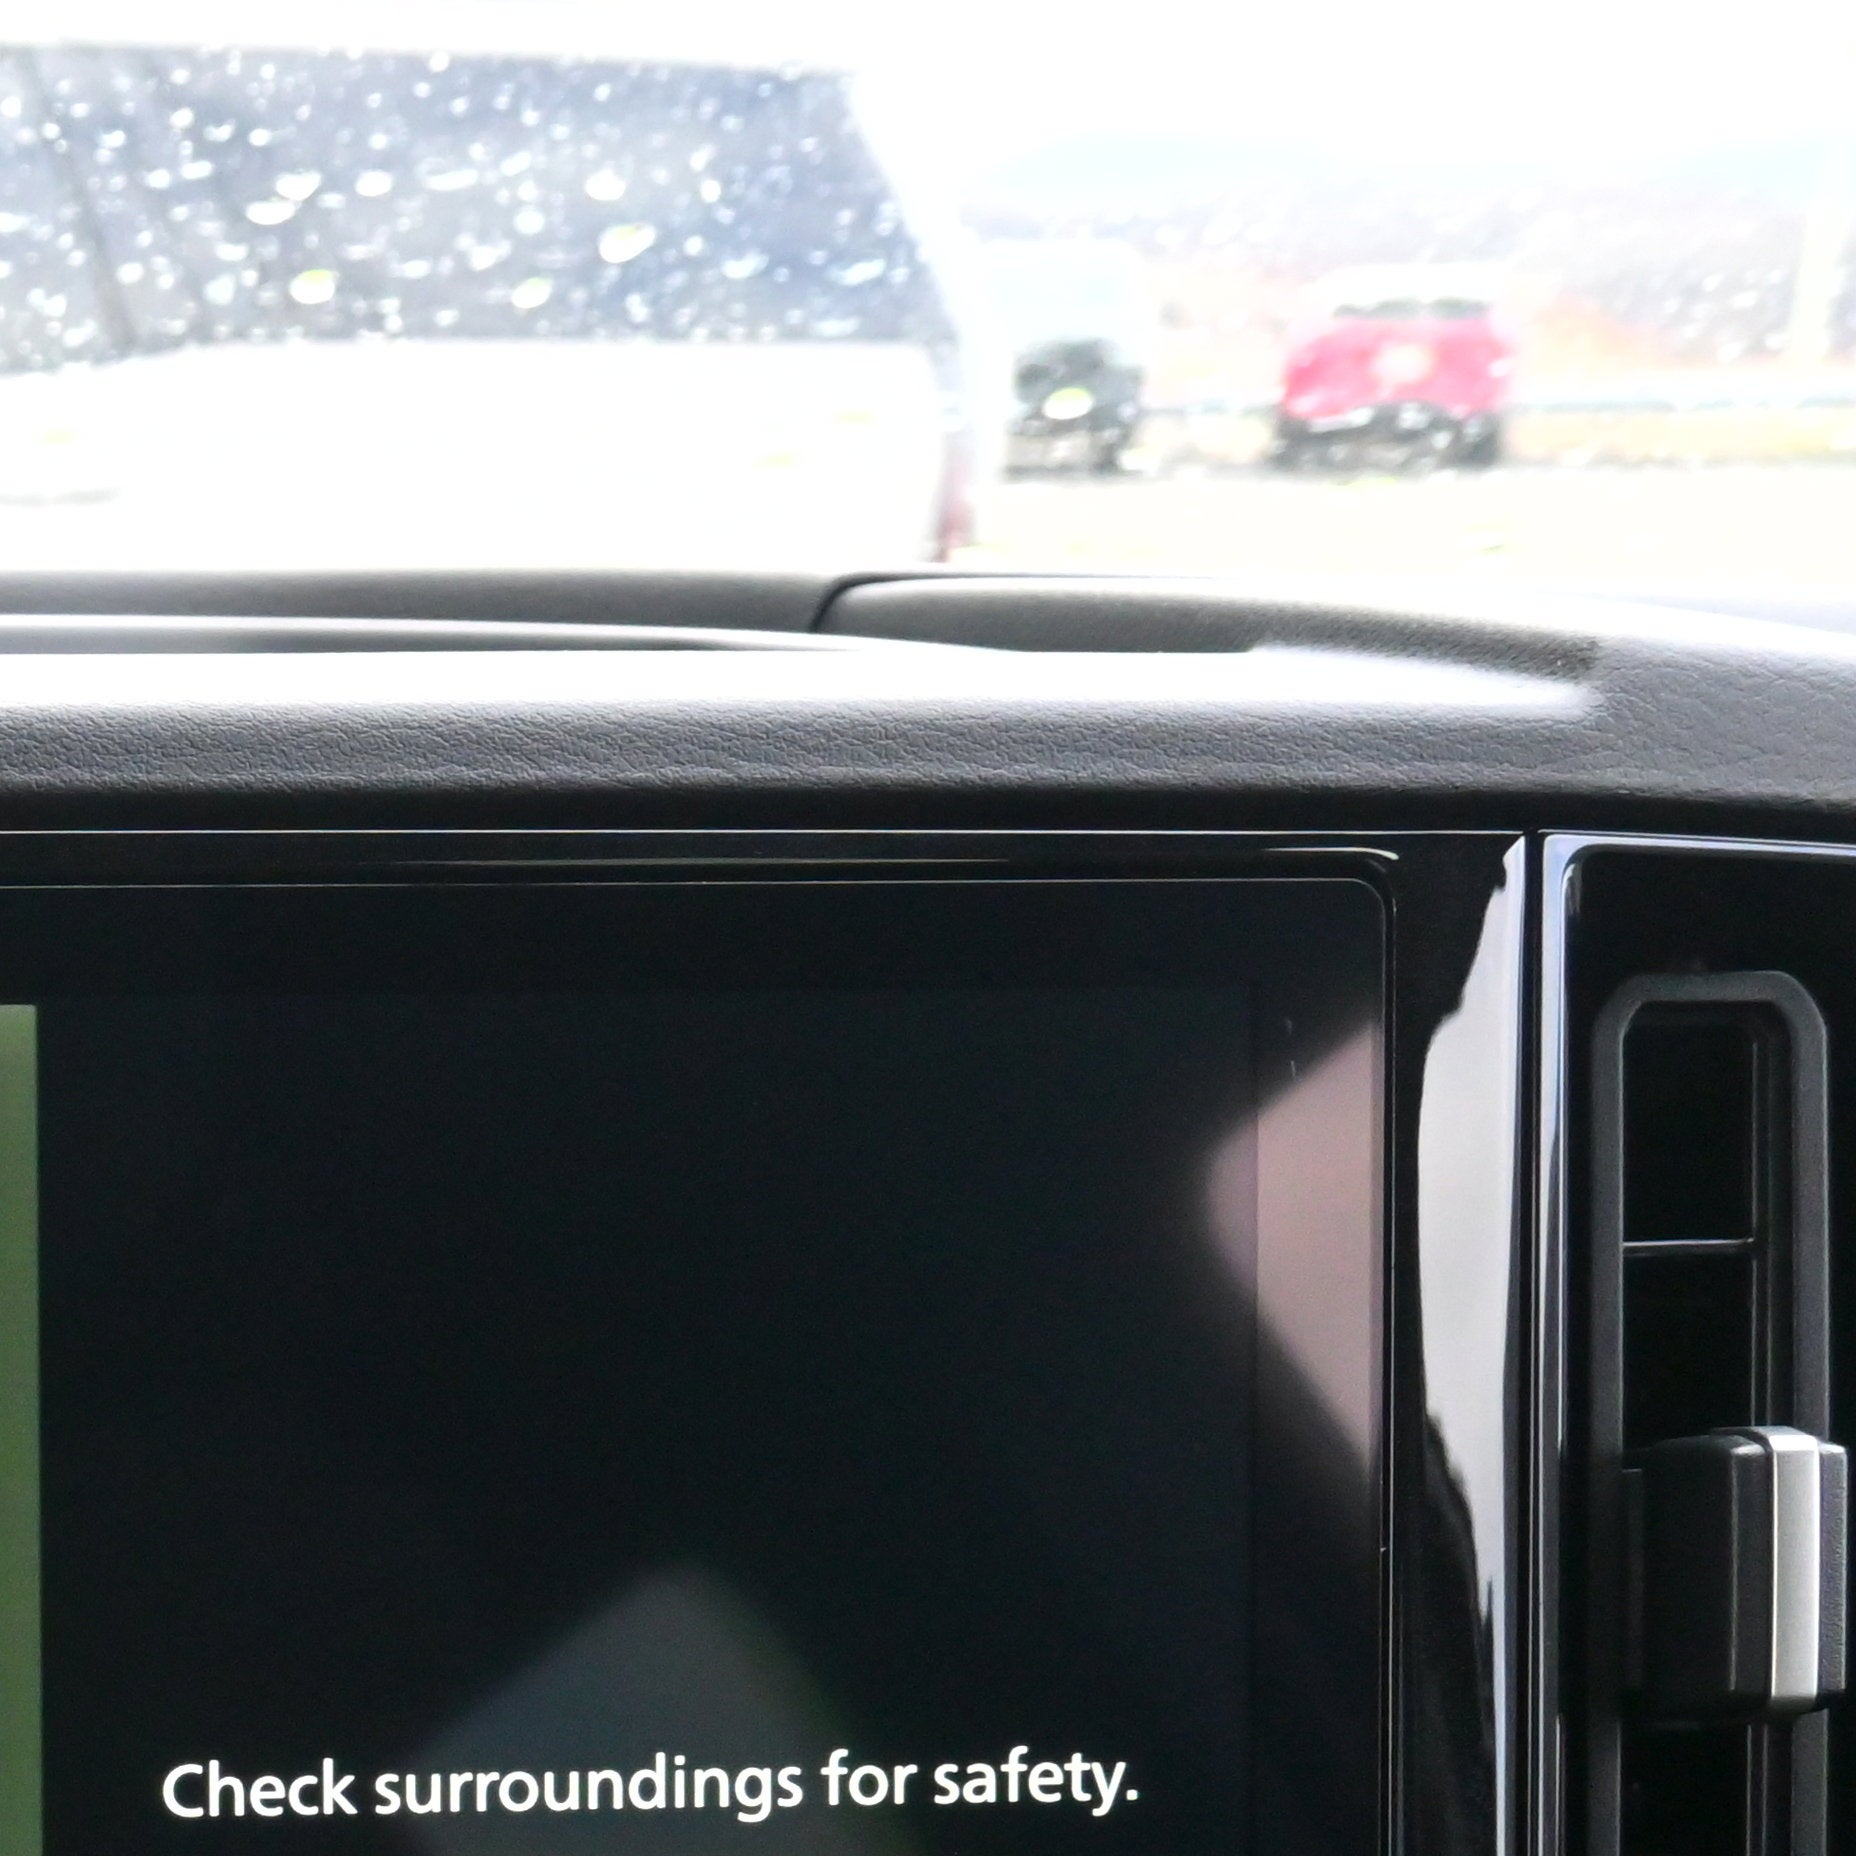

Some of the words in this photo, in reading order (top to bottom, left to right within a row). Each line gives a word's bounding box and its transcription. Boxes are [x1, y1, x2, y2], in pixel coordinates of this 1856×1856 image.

[162, 1757, 358, 1819] Check
[374, 1751, 804, 1824] surroundings
[819, 1747, 919, 1807] for
[933, 1744, 1139, 1817] safety.
